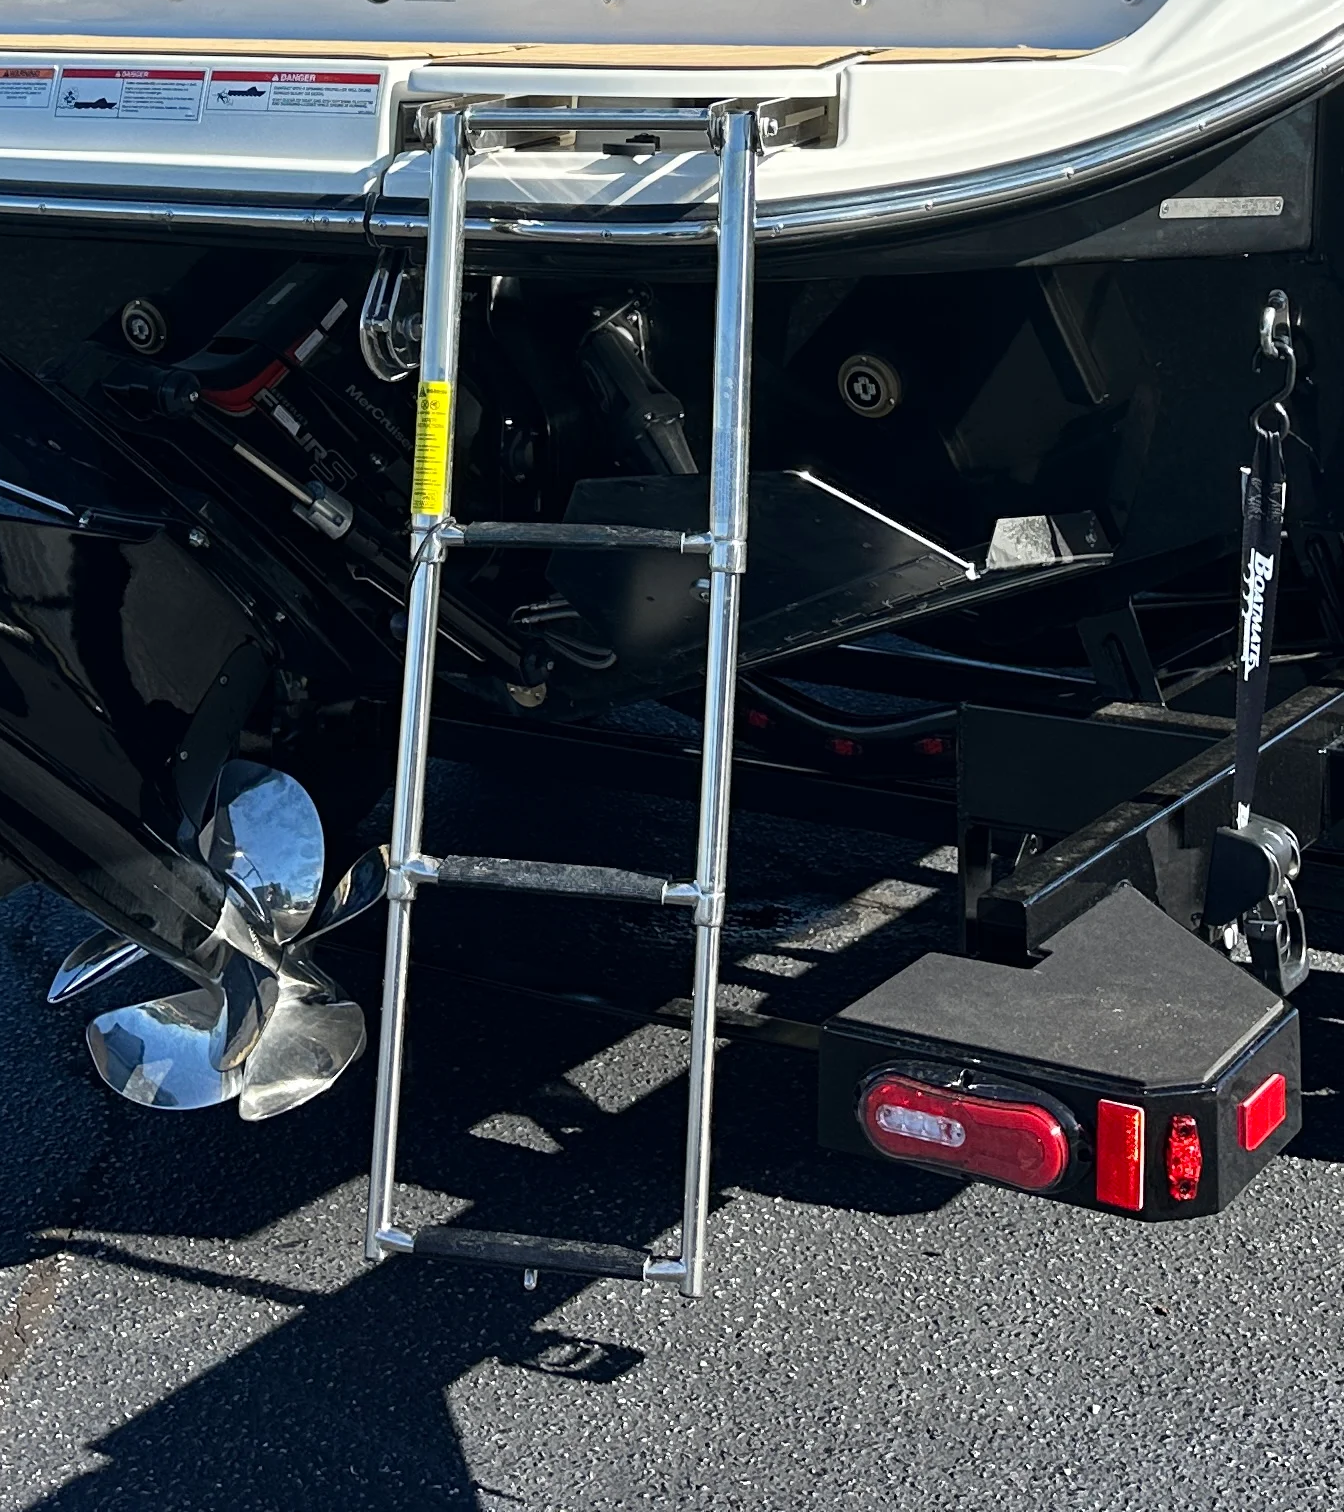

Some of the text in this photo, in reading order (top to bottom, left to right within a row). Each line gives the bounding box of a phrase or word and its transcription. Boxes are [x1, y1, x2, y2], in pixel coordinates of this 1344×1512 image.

[281, 73, 316, 82] DANGER
[345, 384, 414, 452] MerCruiser
[1249, 551, 1274, 668] BOATMATE
